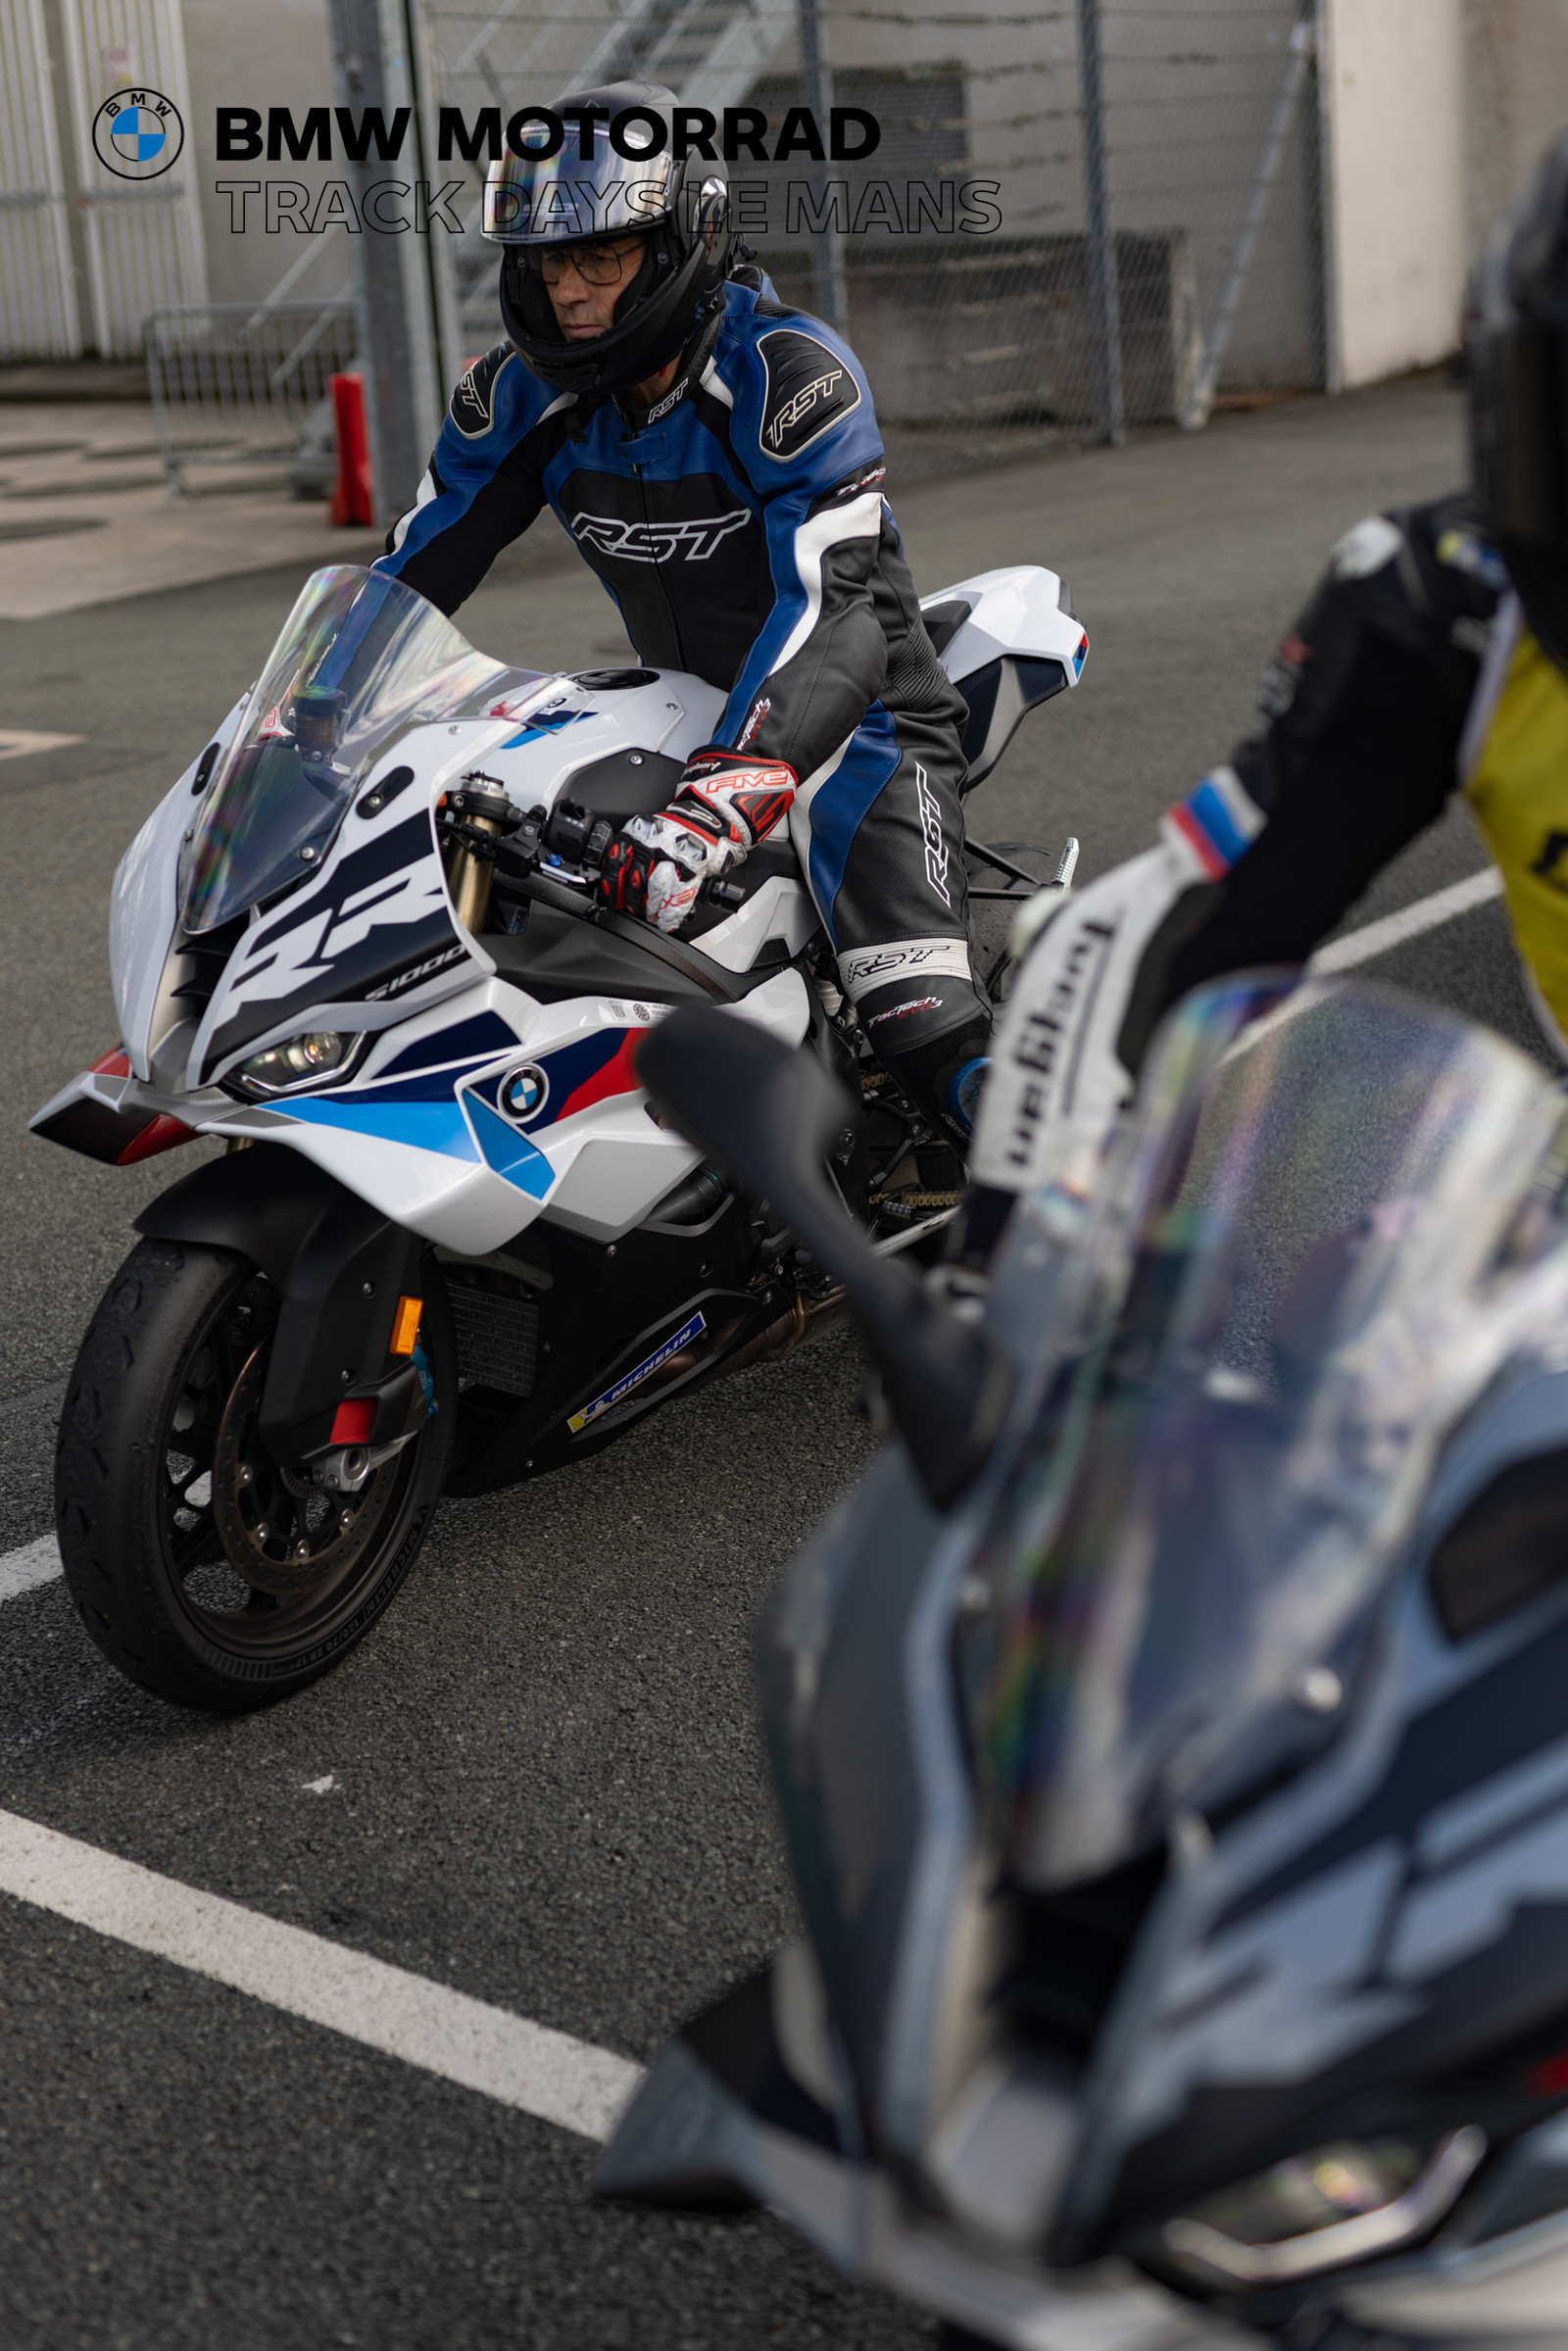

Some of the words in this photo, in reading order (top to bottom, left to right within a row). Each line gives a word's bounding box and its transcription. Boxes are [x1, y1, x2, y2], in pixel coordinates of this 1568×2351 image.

[460, 361, 489, 419] ST
[647, 377, 689, 424] RST
[766, 370, 843, 449] RST
[571, 508, 752, 563] RST
[915, 760, 952, 909] RST
[847, 945, 952, 985] RST
[612, 1328, 692, 1400] MICHELIN
